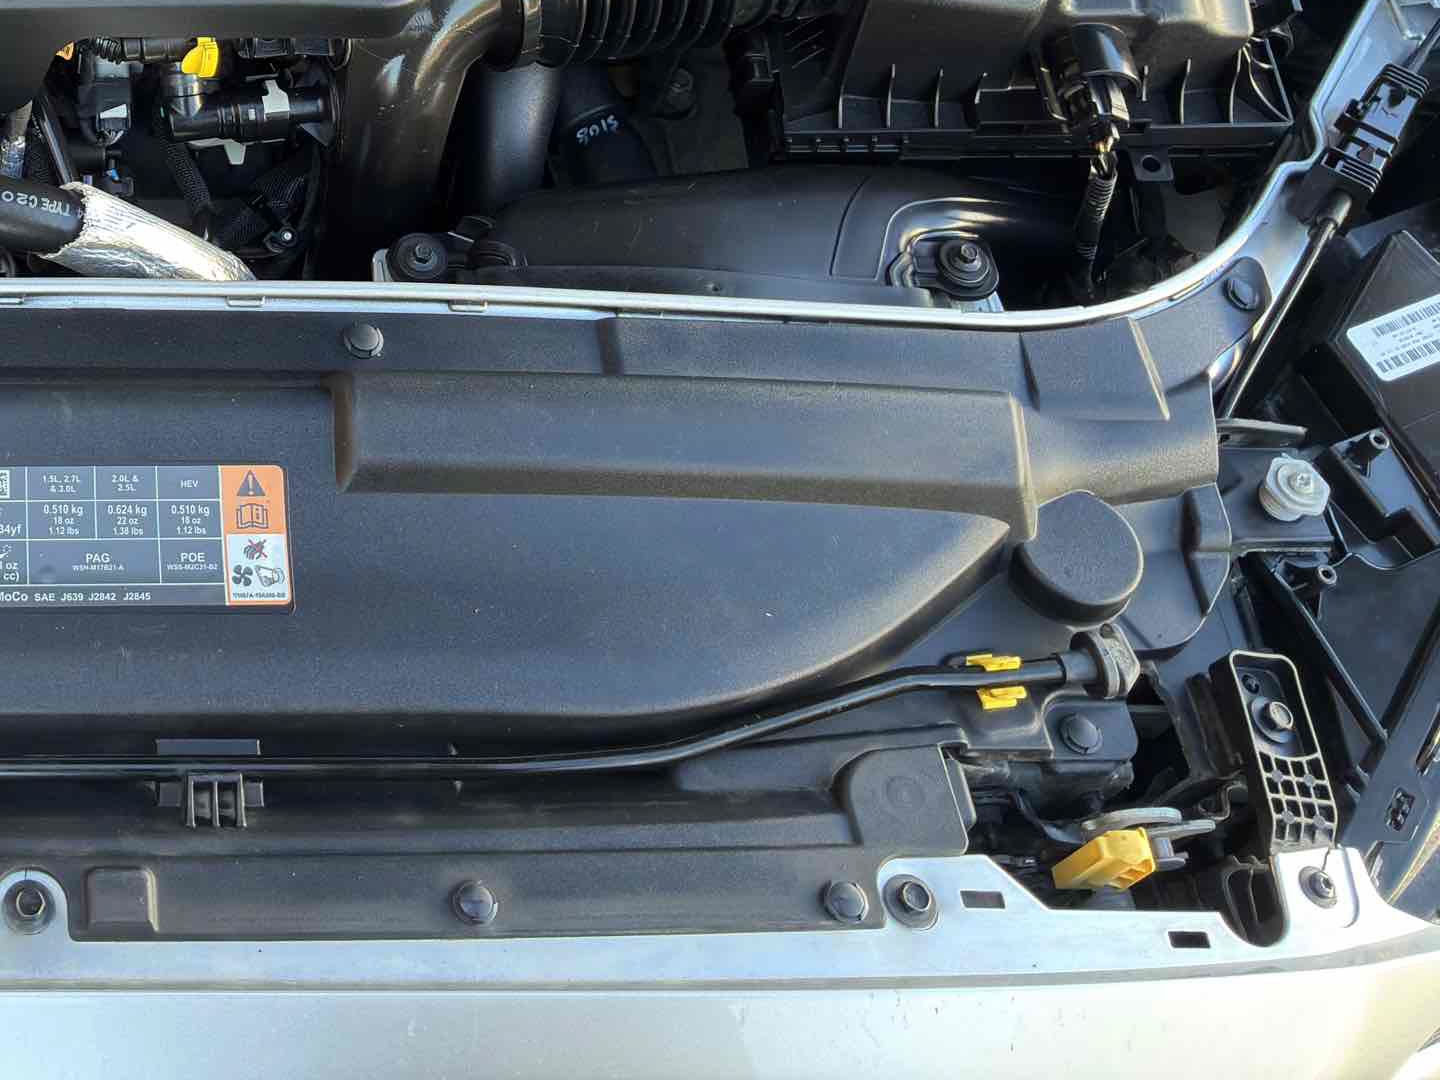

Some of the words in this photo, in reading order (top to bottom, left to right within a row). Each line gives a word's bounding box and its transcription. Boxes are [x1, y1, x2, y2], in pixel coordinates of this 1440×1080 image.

[40, 198, 71, 217] TYPE
[63, 474, 81, 483] 2.7L
[111, 474, 130, 483] 2.0L
[132, 474, 139, 483] &
[180, 479, 199, 488] HEV
[43, 504, 69, 514] 0.510
[71, 504, 84, 517] kg
[107, 504, 133, 515] 0.624
[135, 504, 148, 517] kg
[171, 504, 196, 515] 0.510
[198, 504, 210, 517] kg
[116, 517, 126, 525] 22
[66, 526, 80, 536] lbs
[131, 526, 144, 536] lbs
[176, 526, 192, 535] 1.12
[194, 526, 207, 536] lbs
[85, 553, 110, 564] PAG
[180, 552, 205, 563] POE
[5, 562, 18, 570] oz
[3, 571, 19, 582] cc)
[34, 592, 56, 602] SAE
[60, 592, 83, 601] J639
[88, 592, 116, 601] J2842
[123, 591, 151, 601] J2845
